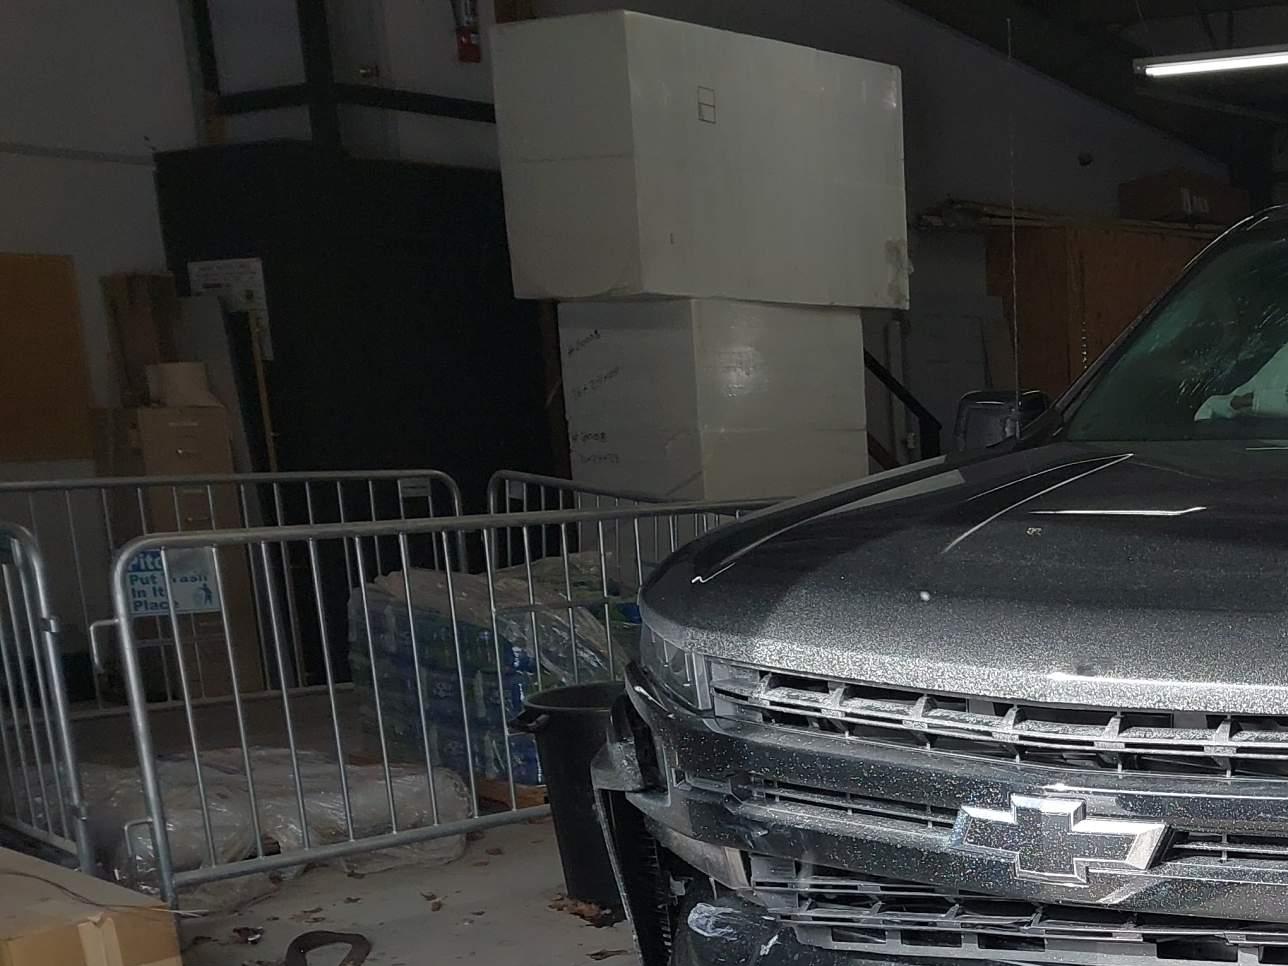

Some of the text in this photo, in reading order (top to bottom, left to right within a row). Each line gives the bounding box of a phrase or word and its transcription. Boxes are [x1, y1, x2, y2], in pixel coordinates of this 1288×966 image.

[130, 574, 159, 586] Put
[131, 586, 169, 599] In It
